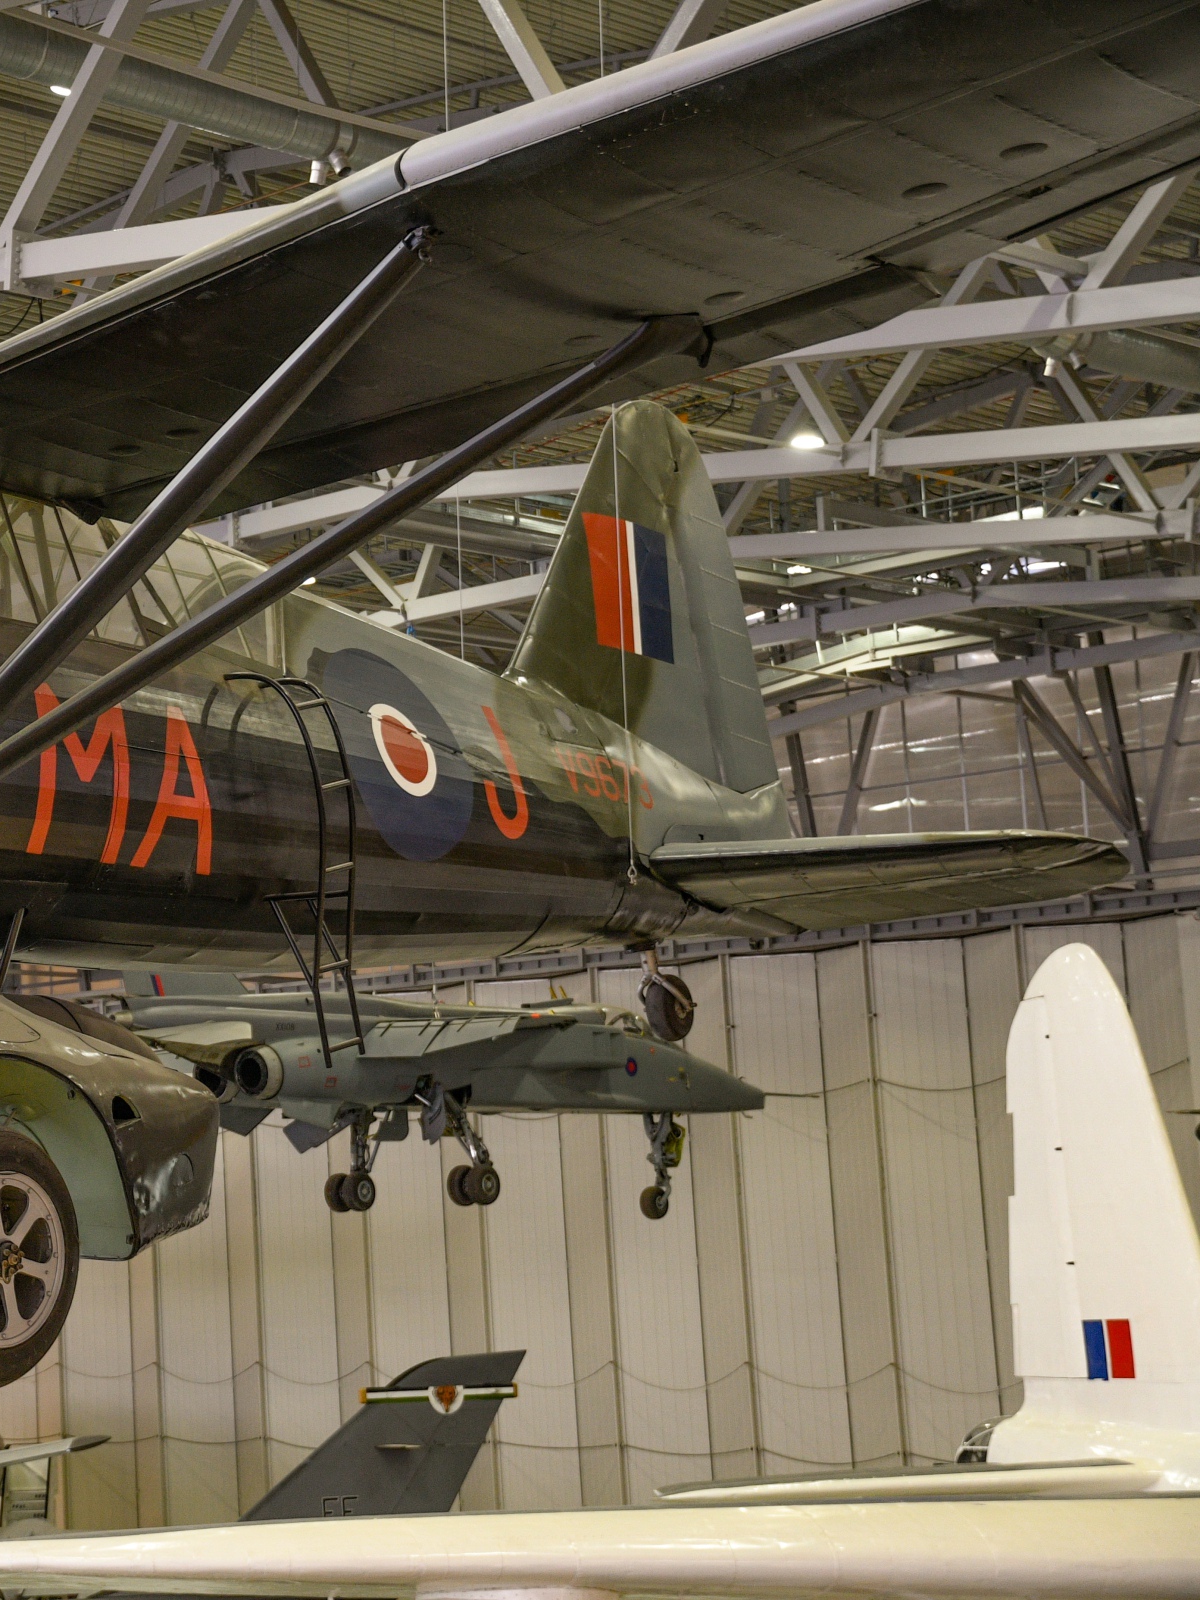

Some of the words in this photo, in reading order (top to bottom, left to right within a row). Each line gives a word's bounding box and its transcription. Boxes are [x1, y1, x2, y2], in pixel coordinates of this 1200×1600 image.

[26, 682, 213, 875] MA
[481, 705, 529, 840] J
[555, 747, 654, 810] V9673
